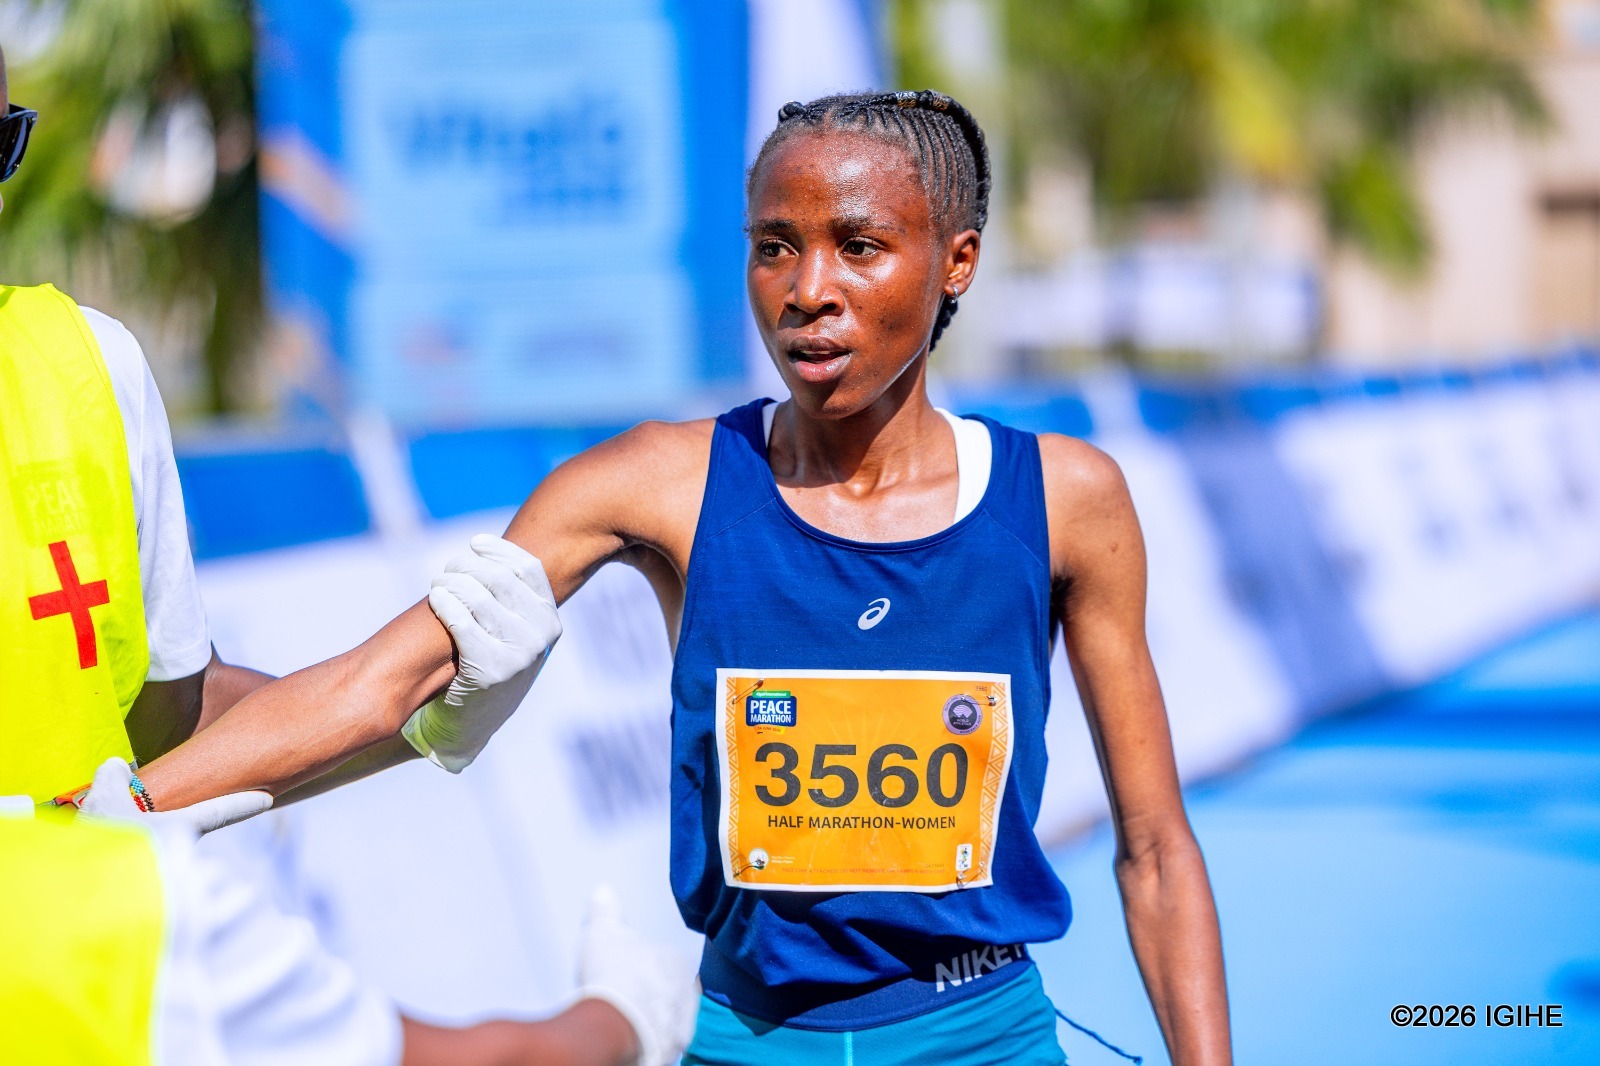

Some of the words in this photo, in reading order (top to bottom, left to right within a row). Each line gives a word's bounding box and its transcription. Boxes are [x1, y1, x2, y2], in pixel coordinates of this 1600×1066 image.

[750, 699, 792, 715] PEACE
[750, 713, 792, 723] MARATHON
[755, 742, 969, 808] 3560
[768, 815, 804, 829] HALF
[808, 815, 956, 830] MARATHON-WOMEN
